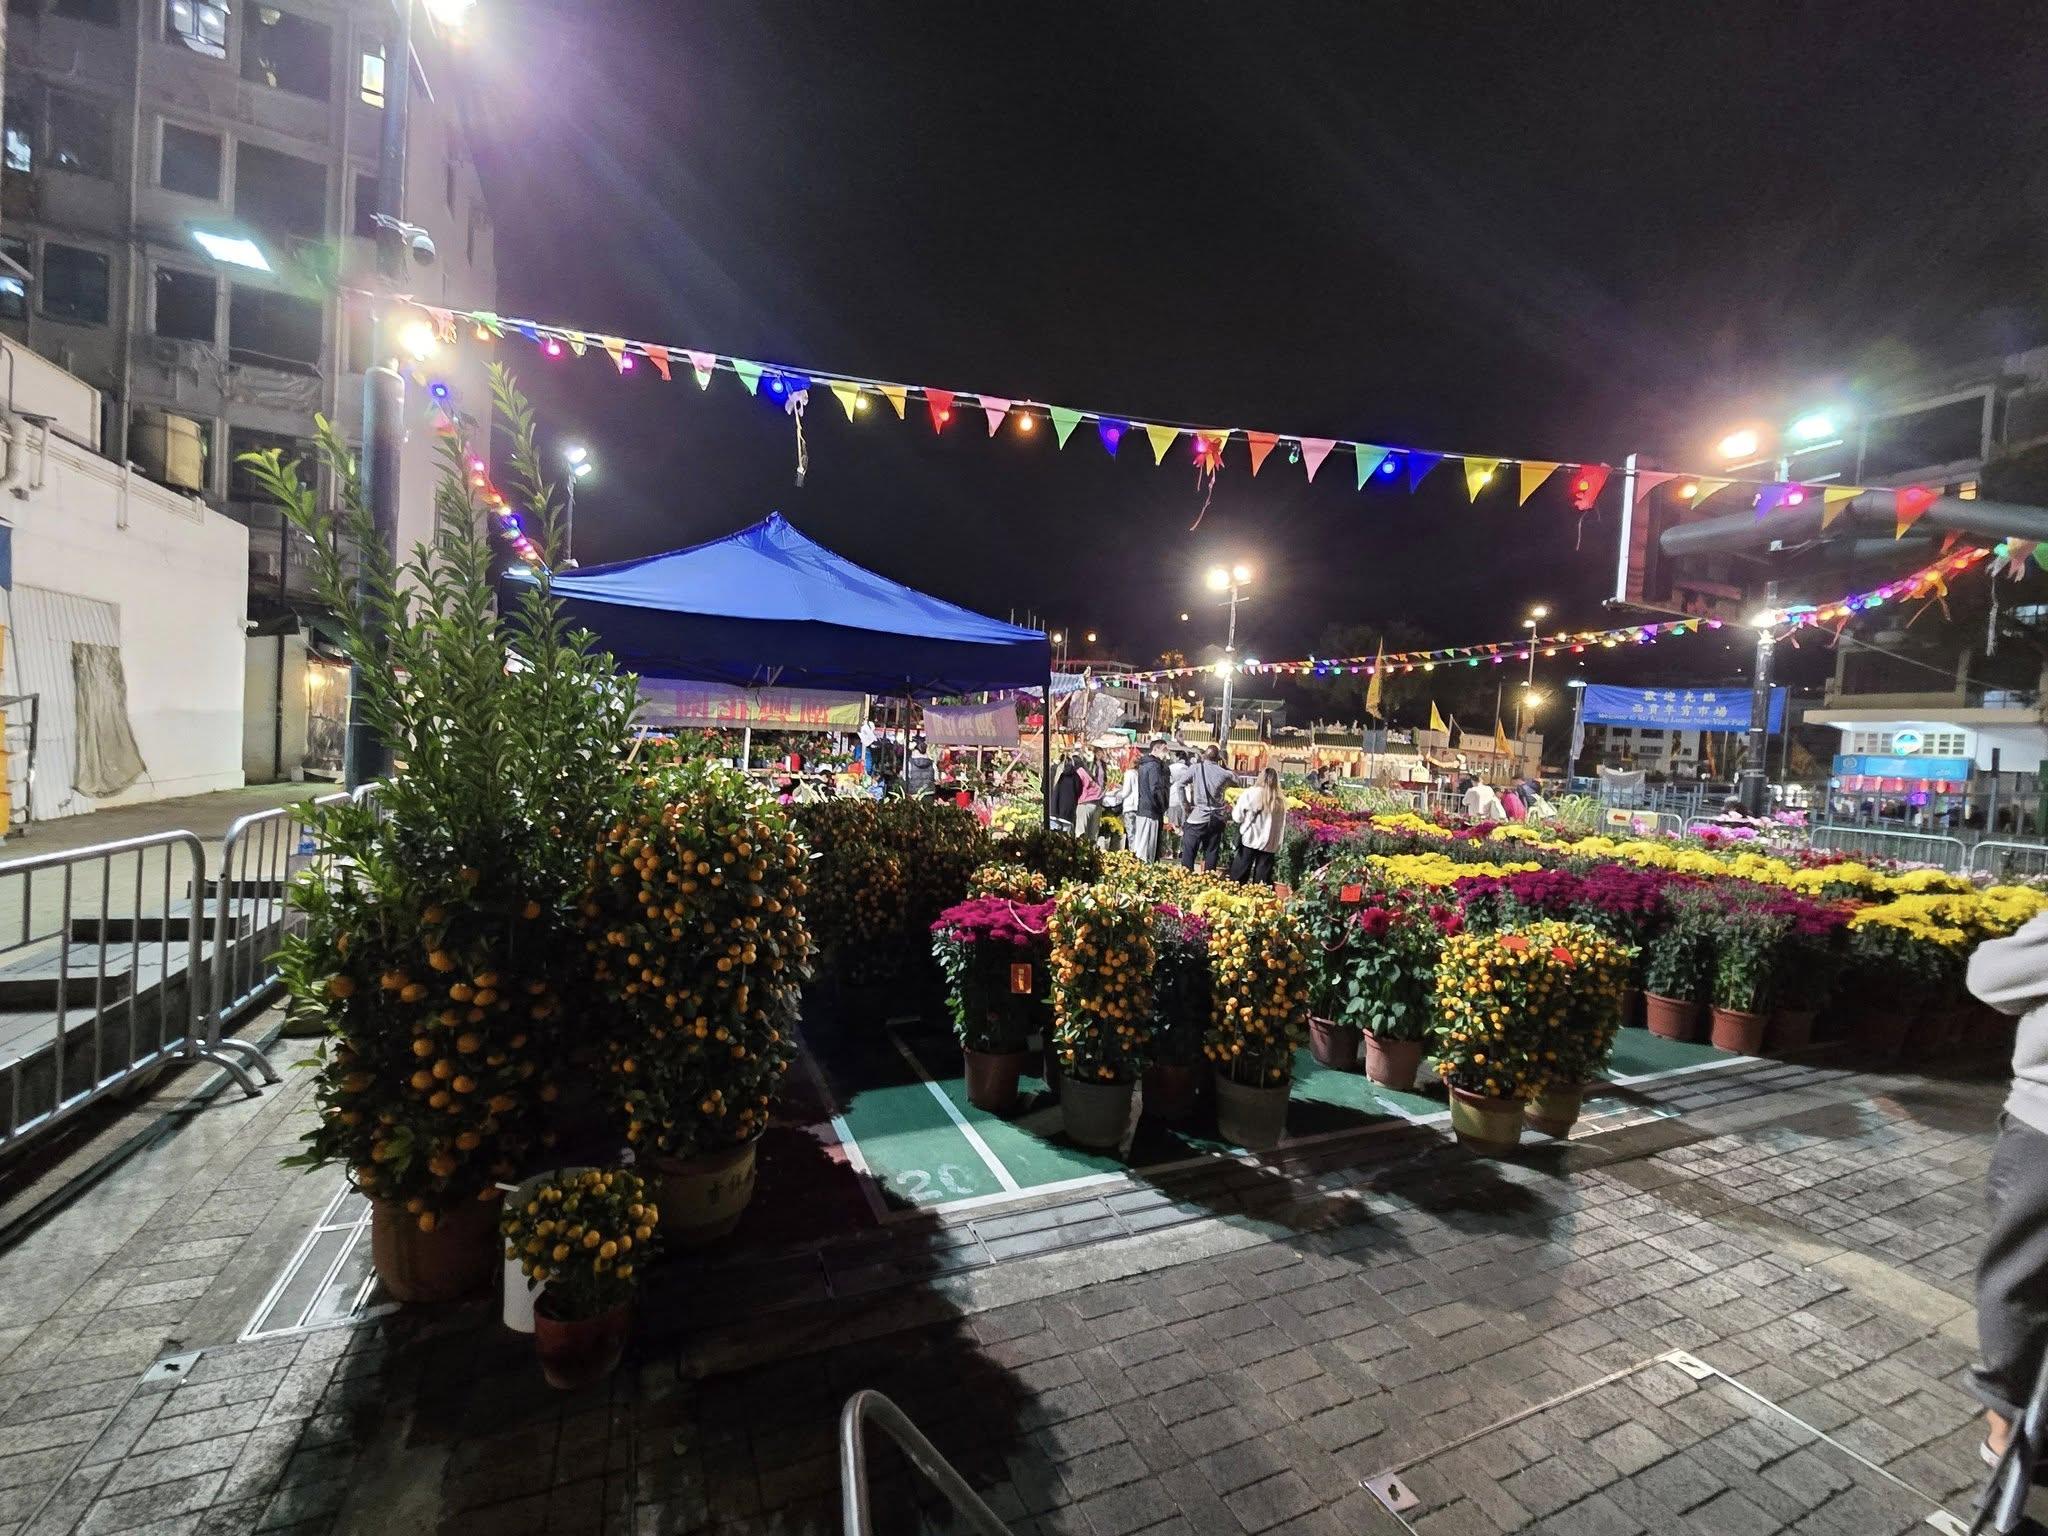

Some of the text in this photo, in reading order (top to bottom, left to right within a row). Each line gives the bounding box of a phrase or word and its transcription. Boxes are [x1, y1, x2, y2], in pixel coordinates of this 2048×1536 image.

[1643, 690, 1716, 703] 歡迎光臨
[1632, 703, 1728, 718] 西貢年宵市場
